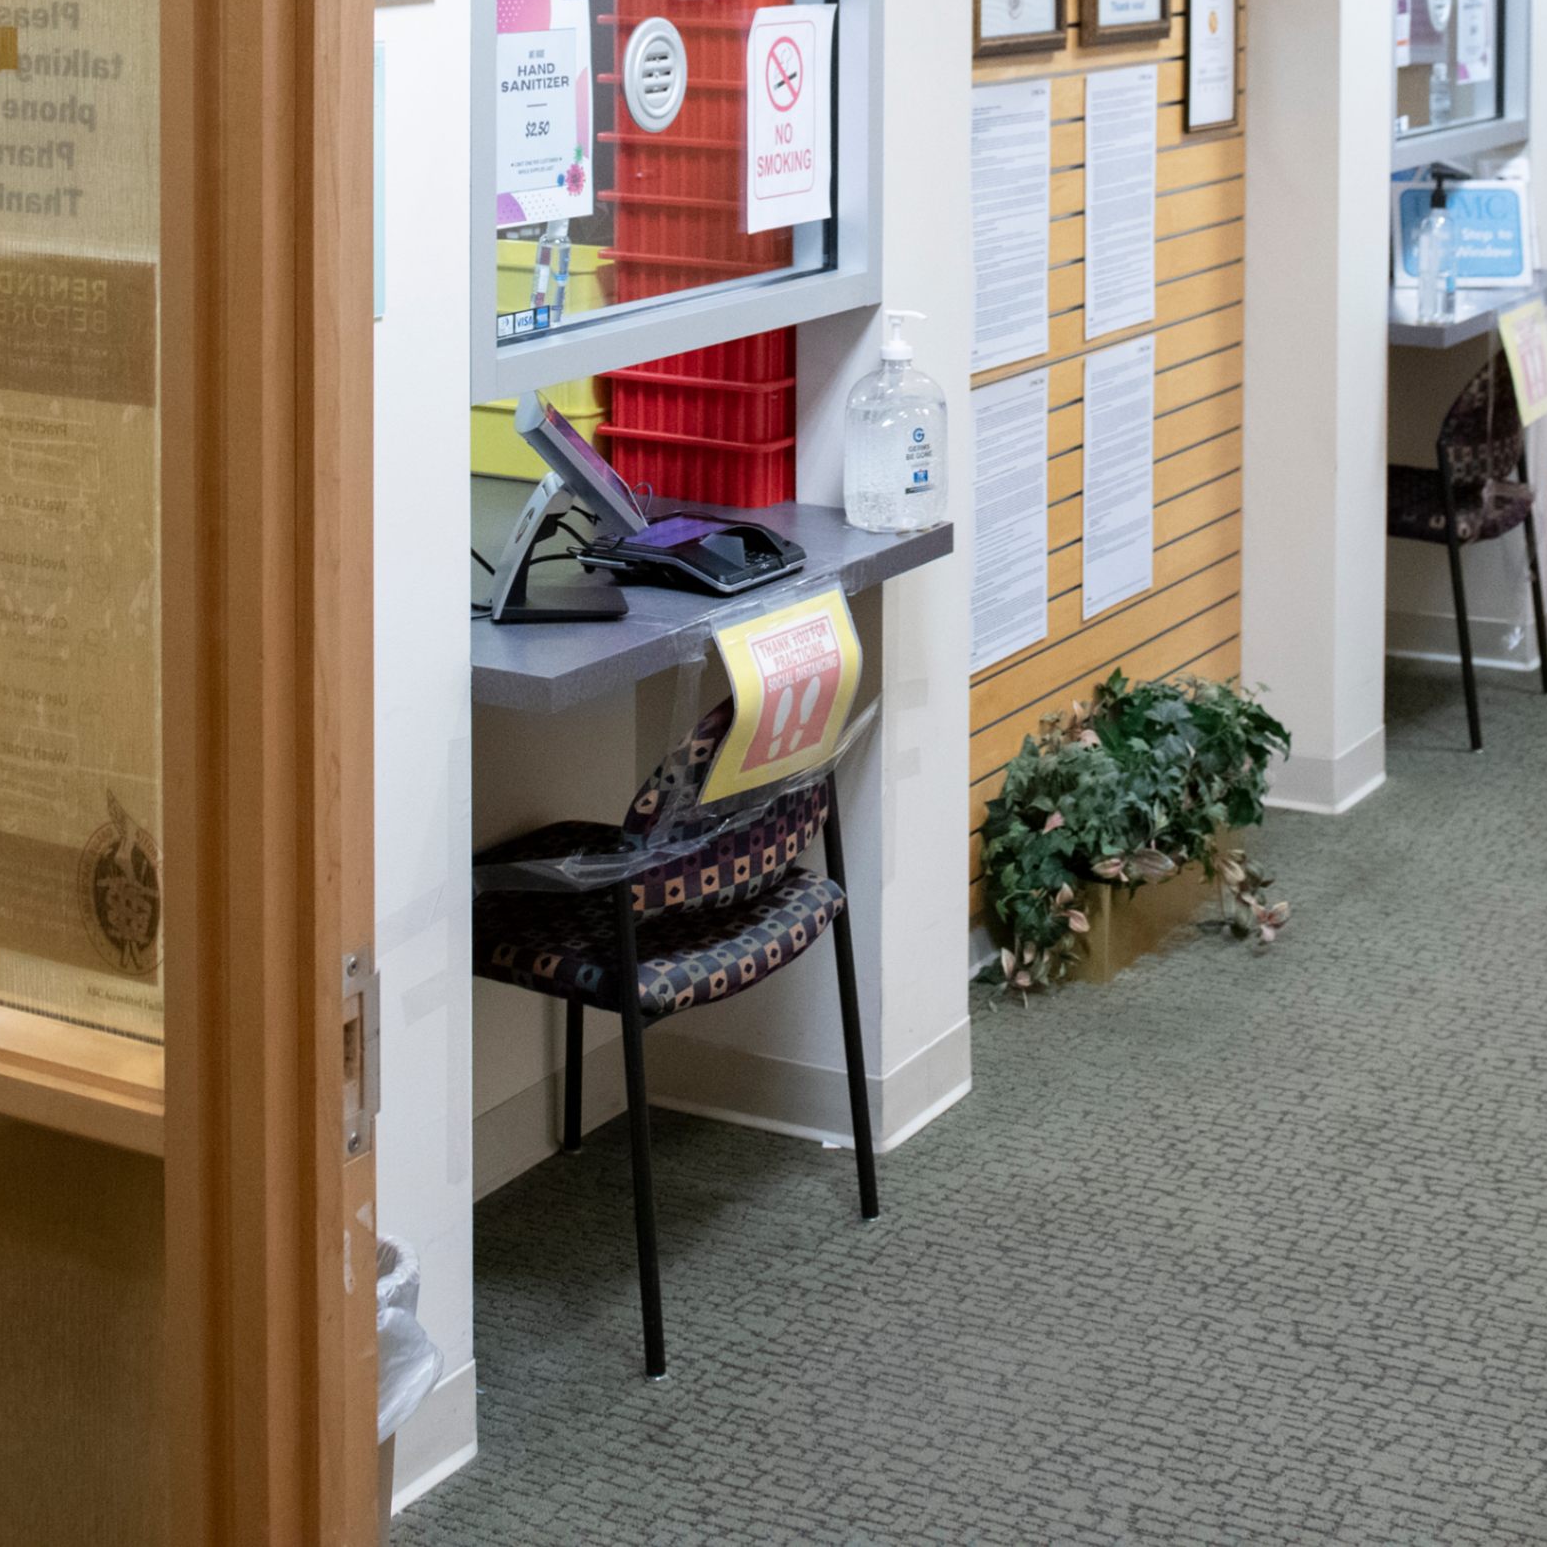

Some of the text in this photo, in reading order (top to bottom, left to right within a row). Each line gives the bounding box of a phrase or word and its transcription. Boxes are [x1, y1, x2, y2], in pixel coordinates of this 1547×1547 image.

[517, 63, 555, 77] HAND
[501, 76, 569, 93] SANITIZER
[526, 120, 549, 138] $2.50
[775, 123, 793, 145] NO
[757, 148, 812, 178] SMOKING
[759, 622, 827, 658] THANK YOU FOR
[774, 641, 825, 671] PRACTICING
[768, 652, 837, 693] SOCIAL DISTANCING
